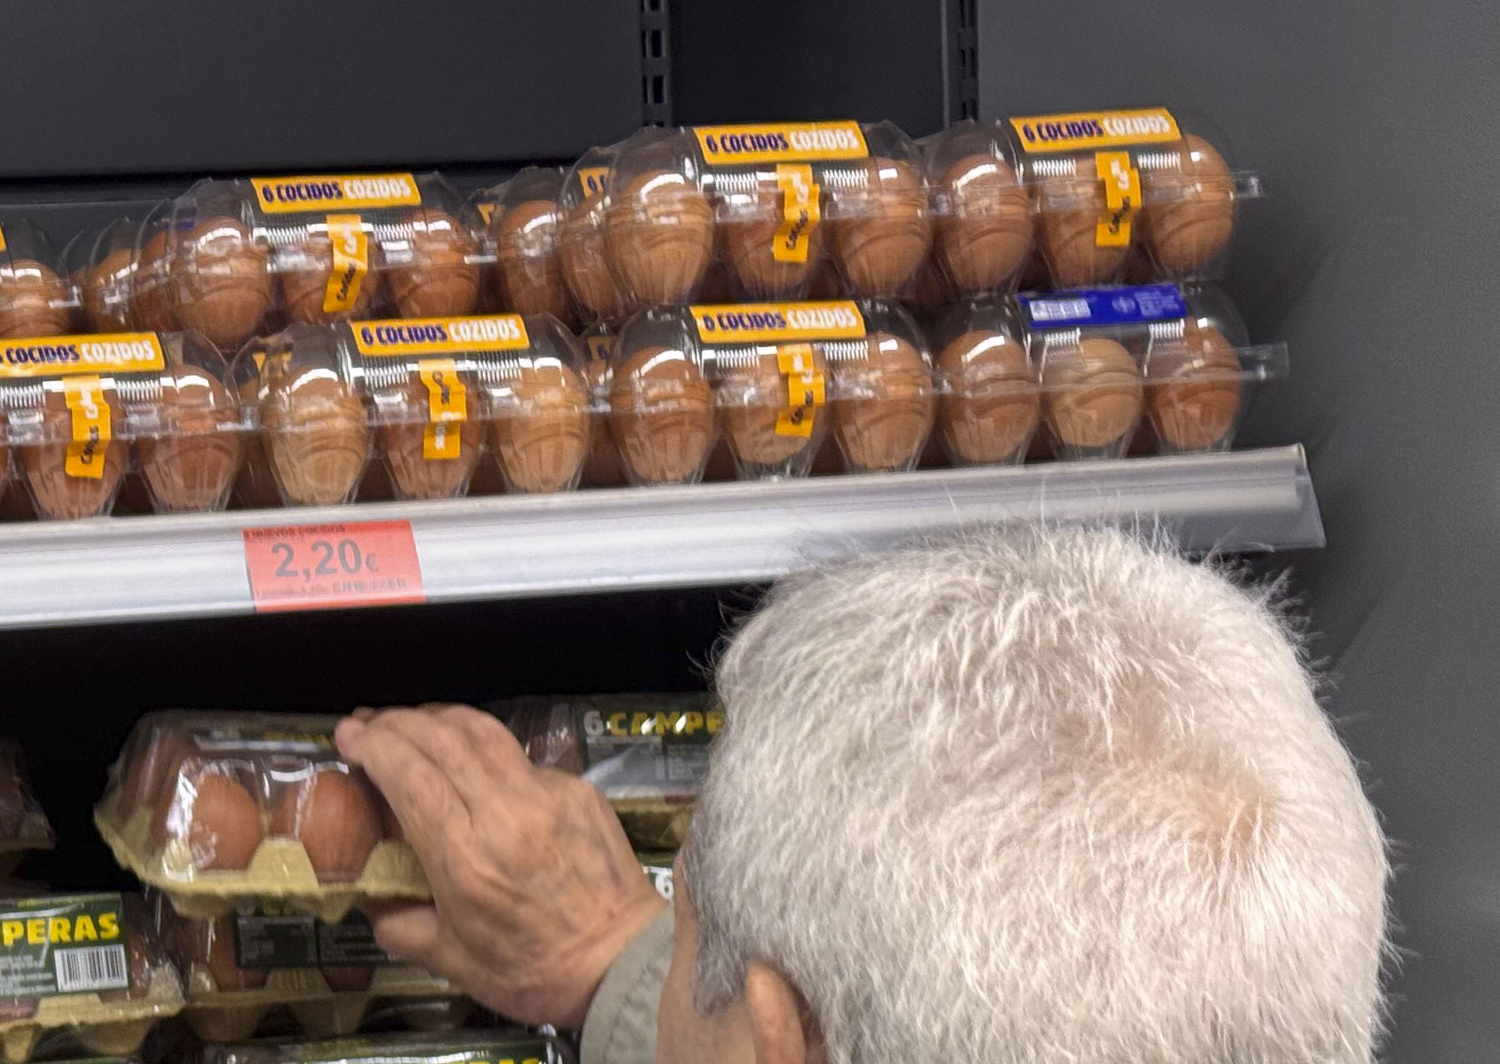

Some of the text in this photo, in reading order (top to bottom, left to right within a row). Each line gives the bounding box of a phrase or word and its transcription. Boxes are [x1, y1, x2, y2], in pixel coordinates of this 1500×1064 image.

[706, 128, 860, 154] 6 COCIDOS COZIDOS
[1037, 119, 1104, 142] COCIDOS
[1103, 115, 1171, 136] COZIDOS
[262, 178, 411, 202] 6 COCIDOS COZIDOS
[361, 319, 521, 346] 6 COCIDOS COZIDOS
[718, 312, 787, 331] COCIDOS
[787, 307, 857, 330] COZIDOS
[6, 344, 80, 365] COCIDOS
[81, 340, 155, 363] COZIDOS
[271, 539, 379, 583] 2,20€
[584, 710, 725, 737] 6 CAMPE
[655, 871, 674, 900] 6
